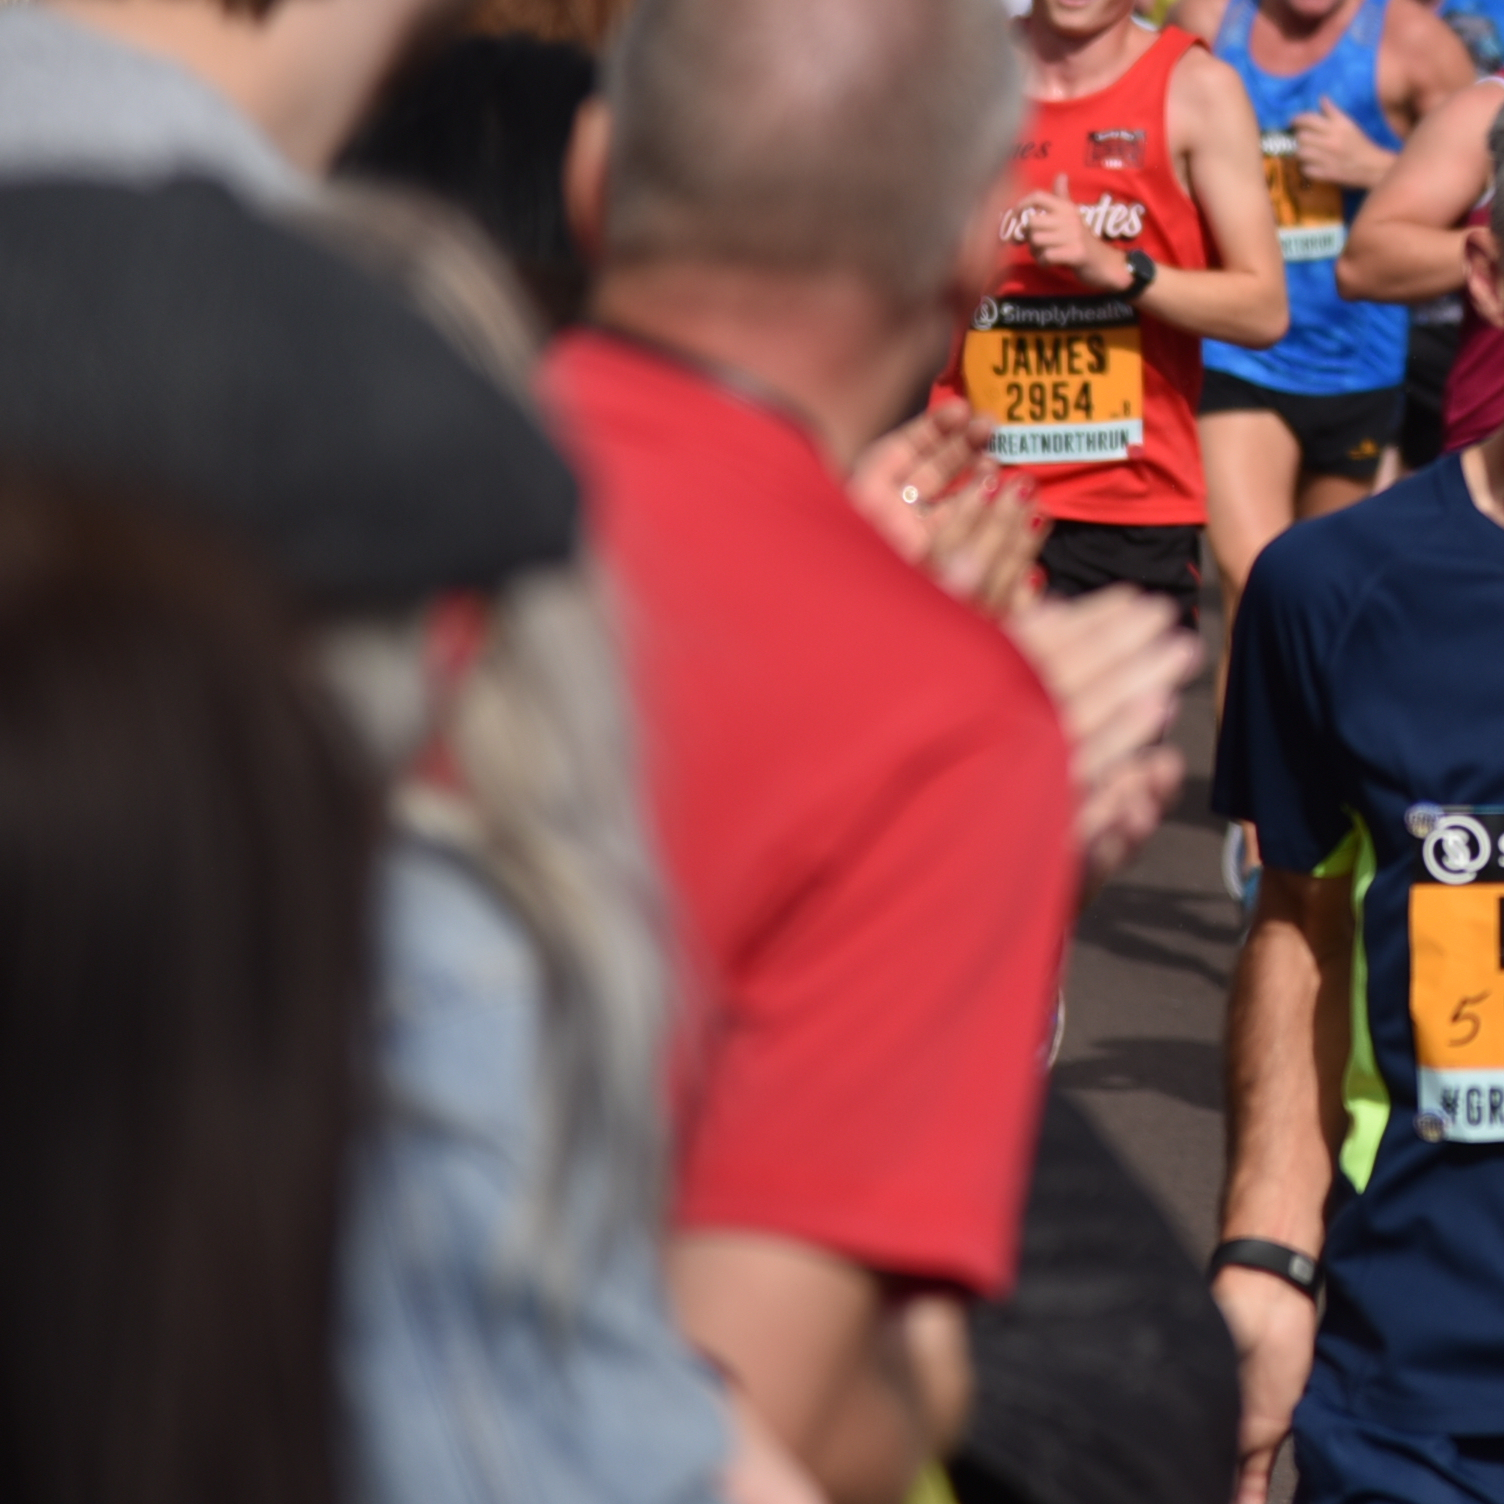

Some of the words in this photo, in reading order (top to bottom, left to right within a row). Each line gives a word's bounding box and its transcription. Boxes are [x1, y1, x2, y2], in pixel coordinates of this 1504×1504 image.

[992, 333, 1109, 376] JAMES
[1006, 381, 1094, 422] 2954
[988, 429, 1129, 456] GREATNORTHRUN
[1448, 990, 1491, 1047] 5
